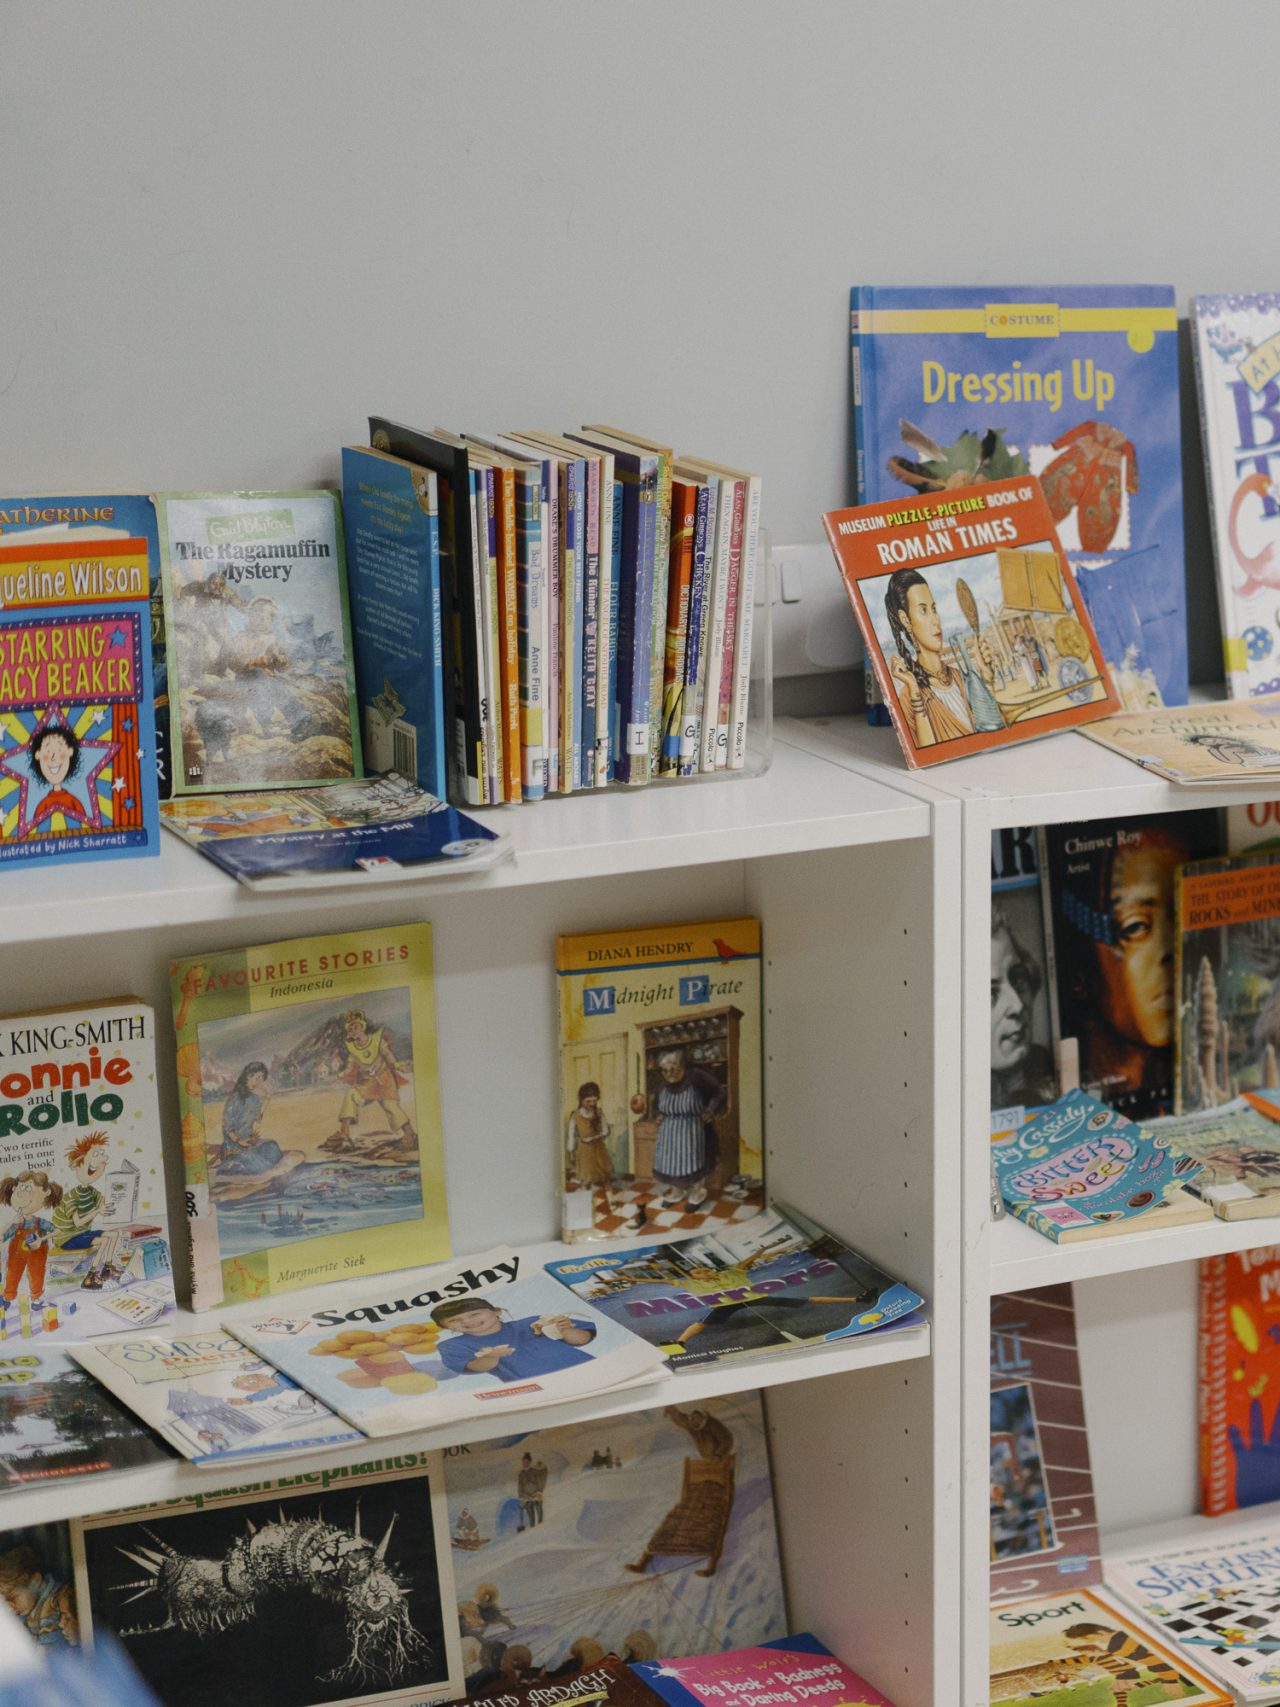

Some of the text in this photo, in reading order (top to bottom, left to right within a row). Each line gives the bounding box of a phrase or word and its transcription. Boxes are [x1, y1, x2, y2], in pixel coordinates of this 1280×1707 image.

[989, 314, 1055, 327] COSTUME
[923, 358, 1115, 412] Dressing Up
[1250, 362, 1269, 383] At
[605, 480, 613, 503] ANNE
[210, 512, 292, 538] Enid Blyton
[838, 487, 1033, 536] MUSEUM PUZZLE-PICTURE BOOK OF
[927, 517, 957, 531] LIFE IN
[176, 540, 330, 563] The Ragamuffin
[552, 499, 560, 580] DRAKE'S DRUMMER
[694, 491, 709, 599] ALAN GIBBONS CHICKEN
[876, 517, 1018, 565] ROMAN TIMES
[221, 563, 293, 582] Mystery
[700, 487, 717, 629] Lucy Boston The River Green
[724, 489, 745, 653] ALAN DAGGER THE SKY
[70, 561, 142, 595] Wilson
[504, 480, 518, 706] The Muddle-headed WOMBAT holiday Ruth
[609, 496, 622, 661] ANNE FINE FLOUR BABIES
[602, 598, 610, 628] ANGEL
[679, 584, 690, 628] DICTIONARY
[735, 489, 760, 746] ARE YOU THERE MARGARET Judy Blume Piccolo
[433, 612, 442, 666] KING-SMITH
[531, 550, 542, 702] Bad Dreams Anne Fine
[586, 557, 599, 708] The Runner KEITH GRAY
[706, 495, 732, 753] THEN MAYBE Piccolo
[47, 658, 133, 697] BEAKER
[601, 645, 609, 682] NITSHILL
[684, 725, 696, 738] G
[1151, 713, 1229, 725] Great
[717, 733, 729, 748] G
[45, 834, 128, 856] by Nick Sharratt
[255, 830, 325, 847] Mystery
[331, 830, 346, 839] at
[350, 826, 378, 837] the
[382, 820, 415, 835] Mill
[1065, 829, 1145, 856] Chinwe Roy
[1066, 862, 1091, 876] Artist
[1191, 894, 1210, 906] THE
[1216, 887, 1249, 901] STORY
[1251, 885, 1265, 896] OF
[1190, 906, 1232, 925] ROCKS
[588, 941, 694, 962] DIANA HENDRY
[194, 945, 409, 993] FAVOURITE STORIES
[270, 977, 334, 998] Indonesia
[588, 978, 743, 1011] Midnight Pirate
[11, 1016, 145, 1056] KING-SMITH
[27, 1090, 54, 1106] and
[0, 1090, 124, 1138] Rollo
[1019, 1105, 1086, 1149] Cassidy
[21, 1137, 54, 1151] terrific
[24, 1149, 55, 1161] in one
[28, 1157, 55, 1171] book!
[277, 1254, 366, 1284] Marguerite Siek
[313, 1256, 520, 1327] Squashy
[623, 1259, 838, 1318] Mirrors
[672, 1345, 744, 1362] Monica Hughes
[998, 1600, 1088, 1629] Sport
[693, 1661, 843, 1697] Big Book Badness
[697, 1654, 802, 1678] Little Wolf's
[527, 1669, 616, 1706] ARDAGH
[743, 1678, 846, 1707] Daring Deeds
